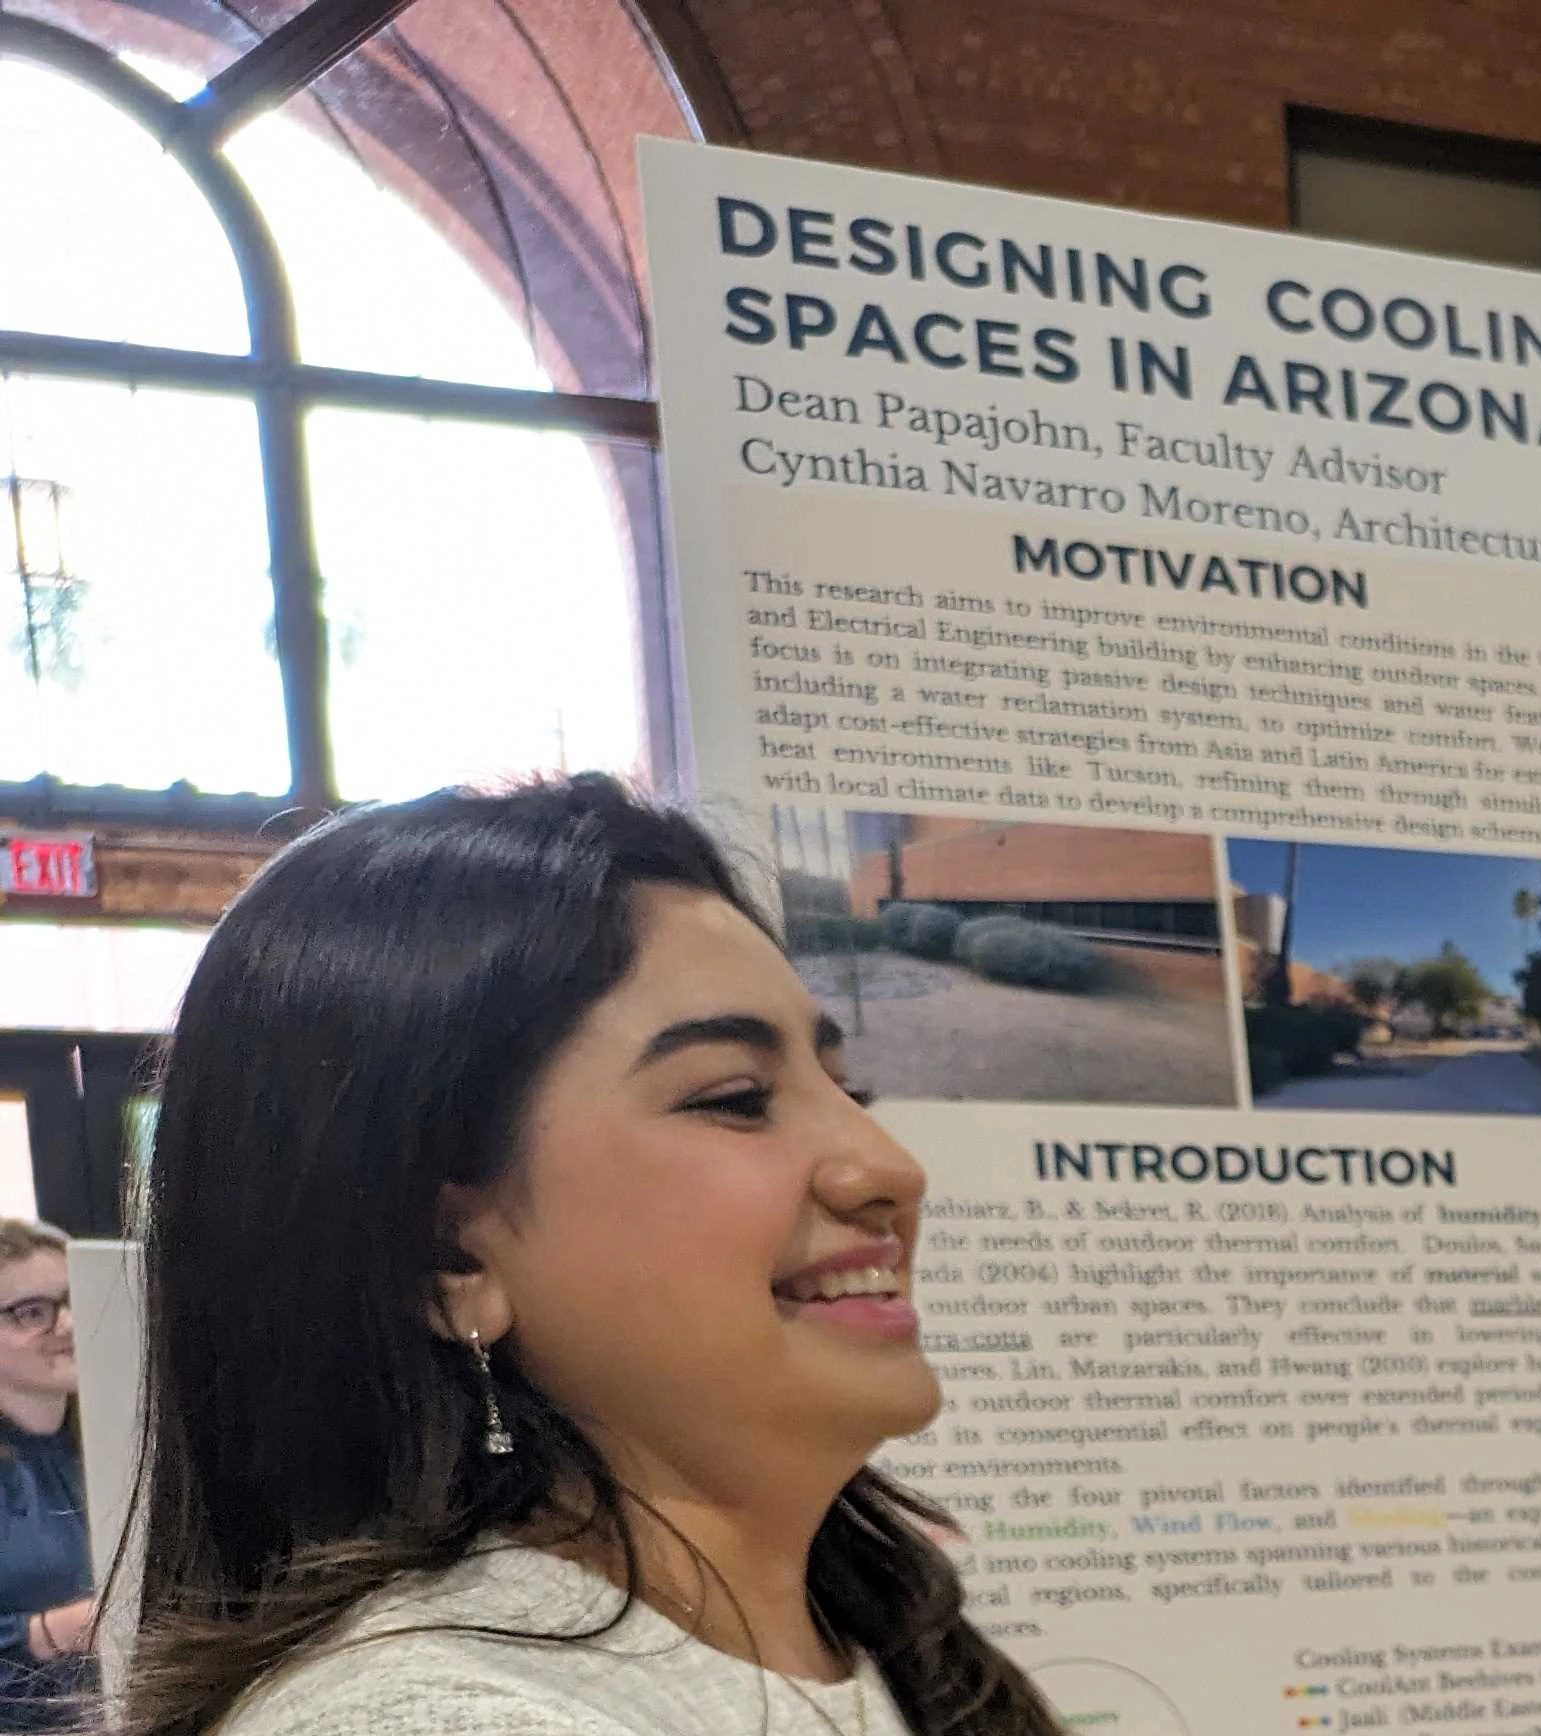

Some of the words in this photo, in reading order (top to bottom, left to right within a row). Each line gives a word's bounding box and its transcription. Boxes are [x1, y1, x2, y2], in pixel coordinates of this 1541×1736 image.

[716, 195, 1211, 320] DESIGNING
[725, 286, 1080, 384] SPACES
[1109, 336, 1192, 401] IN
[733, 374, 860, 425] Dean
[874, 390, 1103, 459] Papajohn,
[1116, 420, 1274, 483] Faculty
[1289, 444, 1446, 494] Advisor
[740, 437, 930, 492] Cynthia
[941, 459, 1126, 514] Navarro
[1138, 480, 1320, 542] Moreno,
[741, 569, 804, 597] This
[814, 581, 924, 609] research
[934, 589, 995, 614] aims
[1004, 597, 1031, 618] to
[1040, 598, 1145, 630] improve
[1012, 534, 1368, 609] MOTIVATION
[746, 605, 797, 629] and
[806, 607, 926, 640] Electrical
[935, 618, 1089, 661] Engineering
[1096, 634, 1199, 671] building
[749, 636, 821, 664] focus
[832, 643, 854, 666] is
[866, 651, 900, 671] on
[912, 649, 1051, 689] integrating
[1059, 667, 1149, 692] passive
[752, 669, 879, 707] including
[891, 685, 905, 703] a
[916, 687, 988, 709] water
[1000, 691, 1148, 722] reclamation
[755, 702, 829, 734] adapt
[837, 713, 1009, 743] cost-effective
[1015, 727, 1131, 757] strategies
[1137, 731, 1198, 758] from
[757, 734, 816, 761] heat
[832, 745, 1013, 775] environments
[1026, 754, 1071, 779] like
[761, 769, 821, 794] with
[827, 772, 888, 798] local
[896, 777, 990, 804] climate
[996, 784, 1049, 809] data
[1055, 792, 1082, 810] to
[1088, 790, 1184, 824] develop
[11, 841, 82, 893] EXIT
[1033, 1141, 1456, 1188] INTRODUCTION
